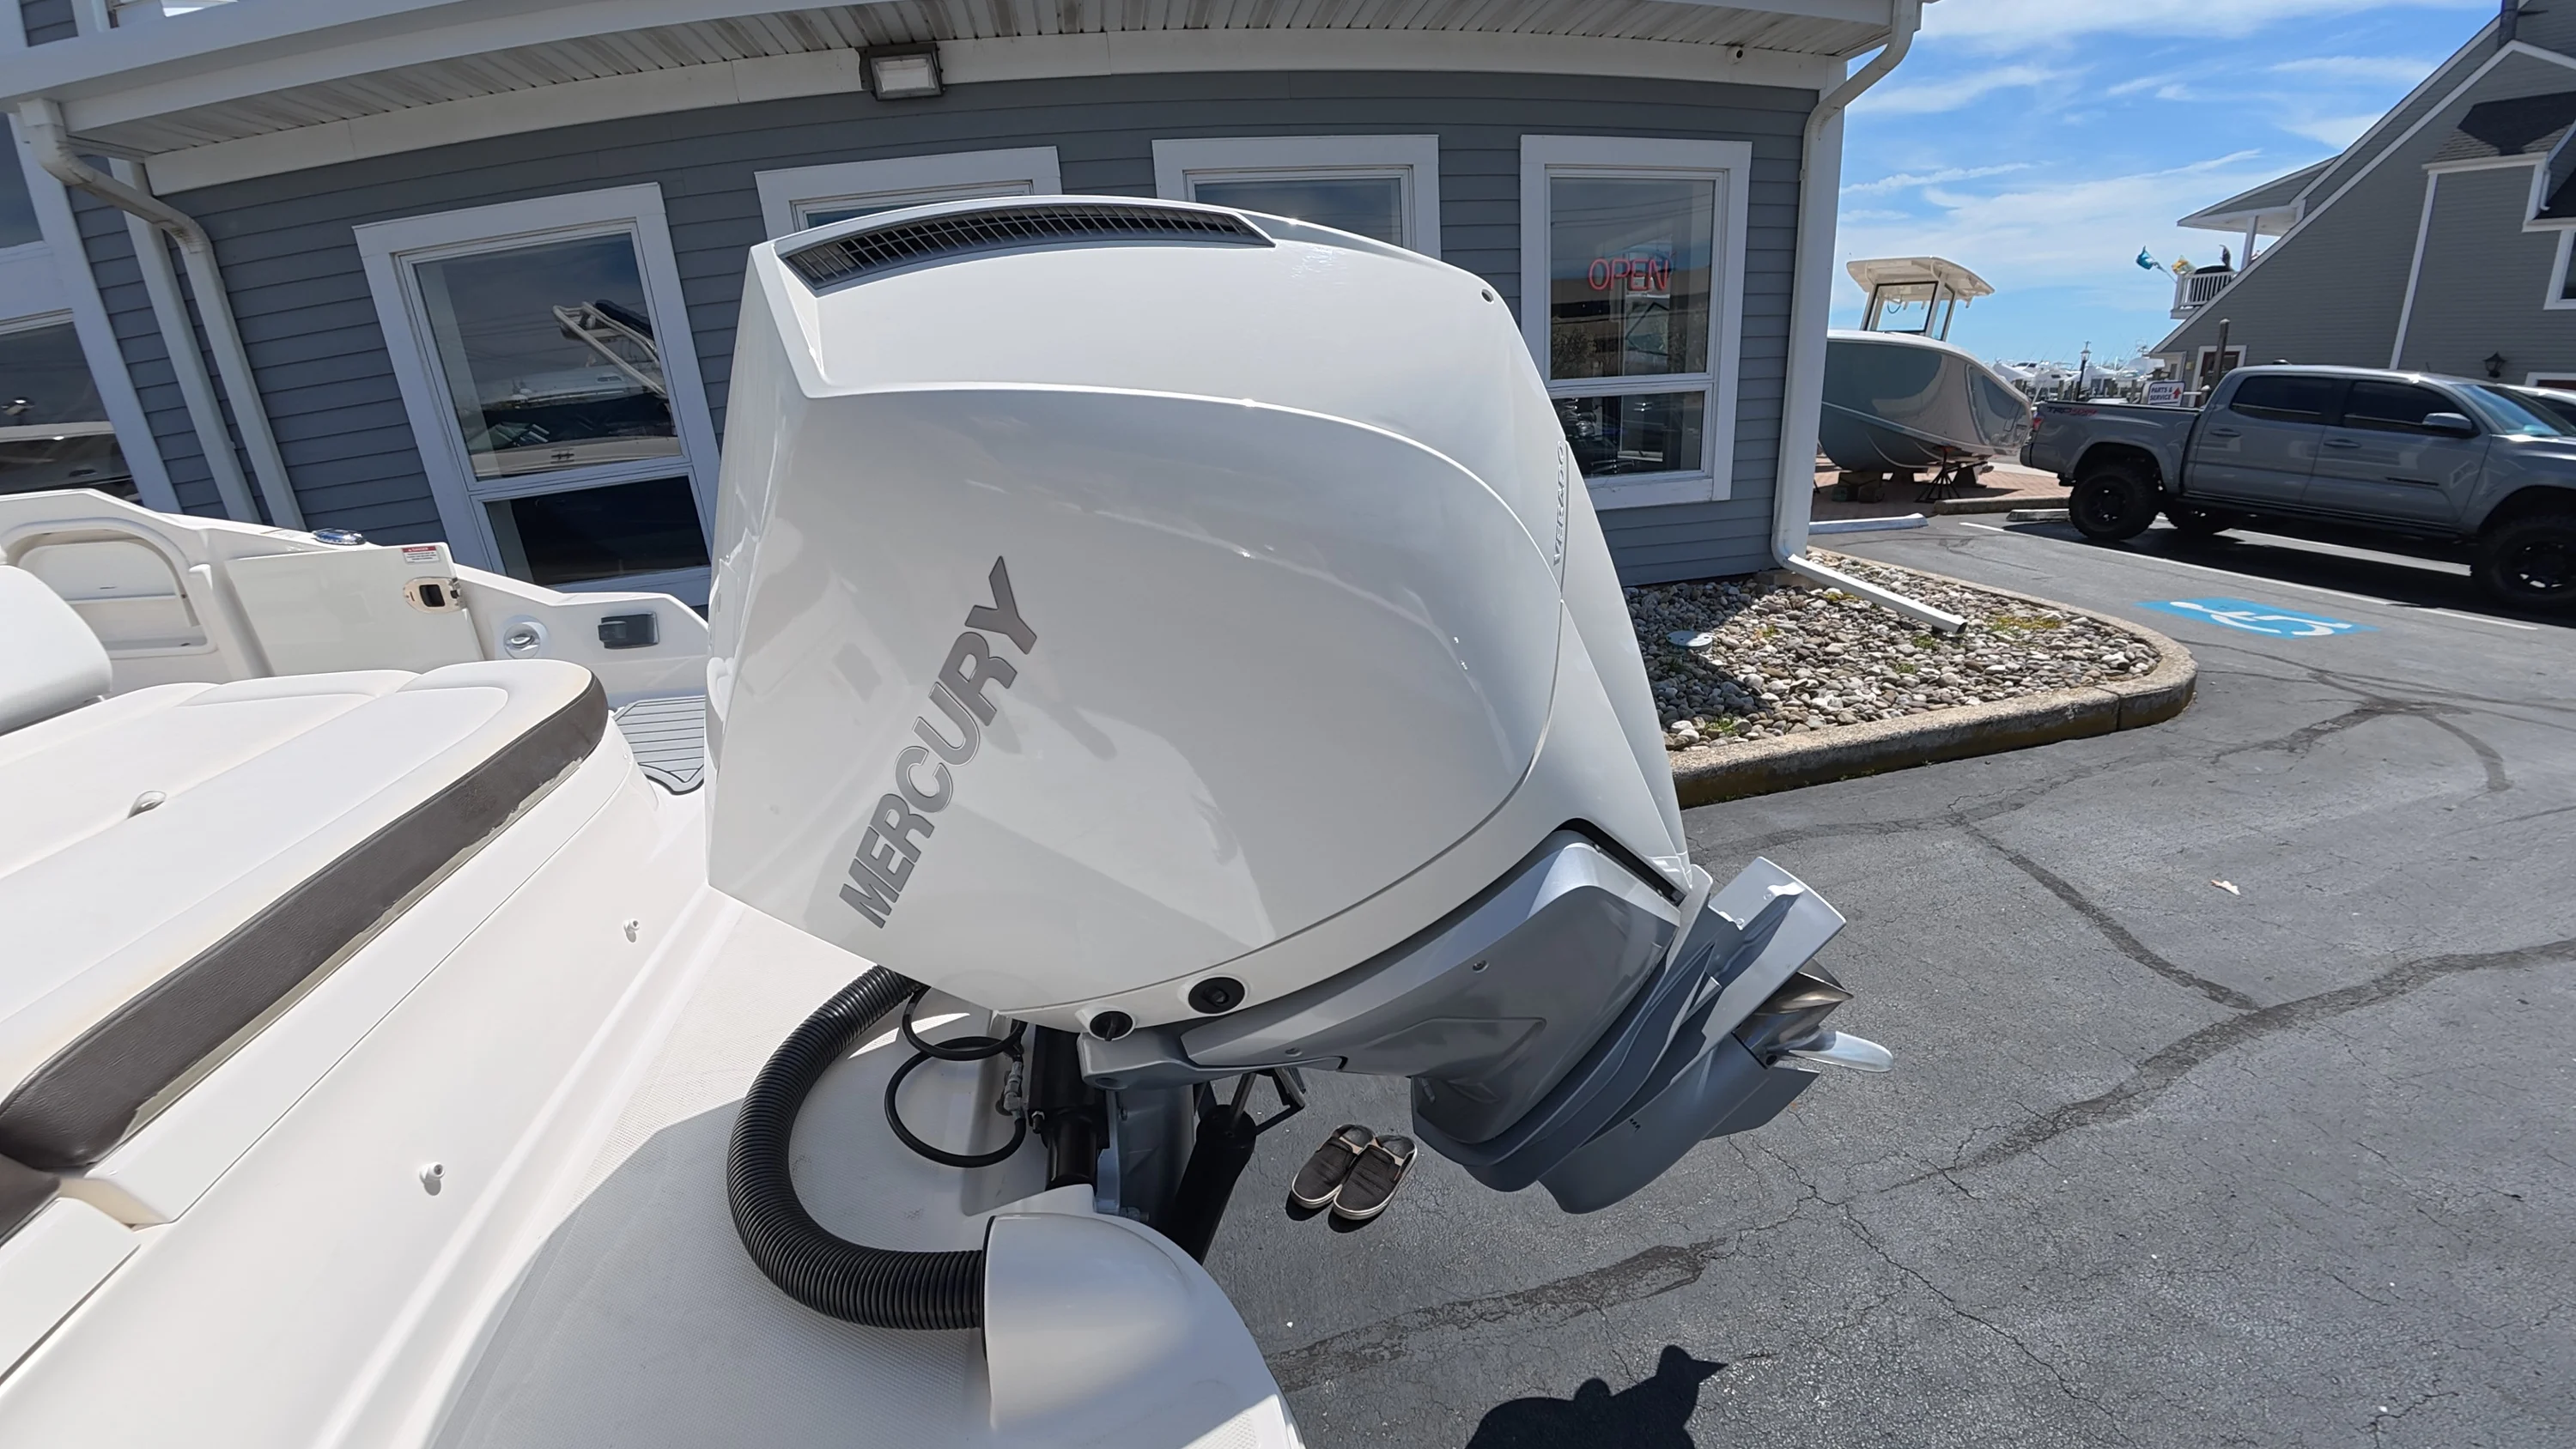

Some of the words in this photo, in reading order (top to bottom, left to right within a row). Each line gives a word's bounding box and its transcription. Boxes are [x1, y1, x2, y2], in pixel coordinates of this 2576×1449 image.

[1589, 258, 1669, 291] OPEN
[1553, 440, 1564, 567] VERADO
[838, 555, 1037, 930] MERCURY
